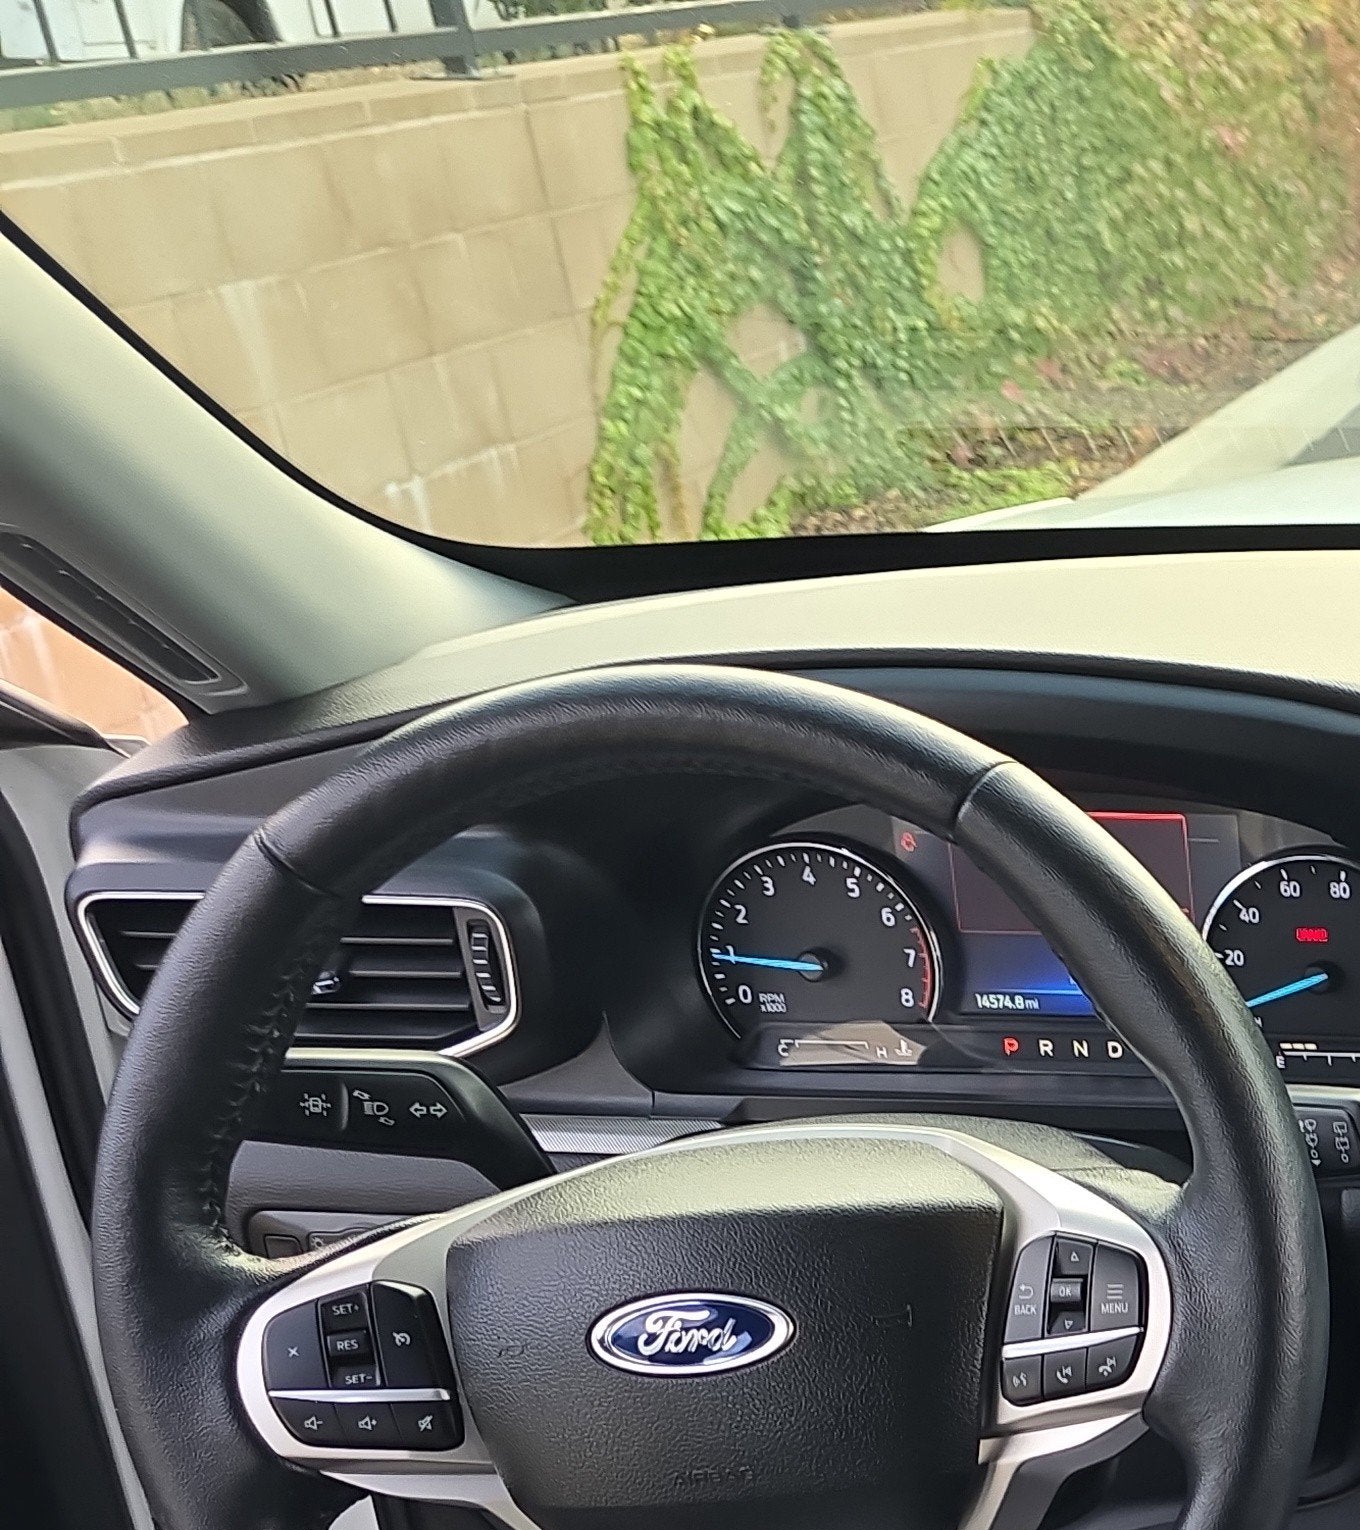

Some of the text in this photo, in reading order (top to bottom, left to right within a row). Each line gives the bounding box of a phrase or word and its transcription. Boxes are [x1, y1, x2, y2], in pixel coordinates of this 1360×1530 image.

[802, 866, 817, 885] 4
[761, 877, 775, 896] 3
[846, 878, 860, 898] 5
[1279, 880, 1301, 898] 60
[1329, 881, 1351, 899] 80
[734, 904, 749, 924] 2
[881, 908, 896, 927] 6
[1239, 907, 1260, 924] 40
[903, 948, 917, 968] 7
[1224, 949, 1244, 966] 20
[738, 985, 753, 1004] 0
[758, 992, 786, 1003] RPM
[900, 987, 915, 1007] 8
[875, 1046, 888, 1058] H
[1003, 1037, 1123, 1059] P R N D
[1275, 1056, 1286, 1069] E
[1058, 1285, 1072, 1297] OK
[331, 1303, 360, 1317] SET+
[1014, 1304, 1037, 1316] BACK
[1101, 1302, 1129, 1315] MENU
[637, 1308, 737, 1356] Ford
[336, 1338, 359, 1351] RES
